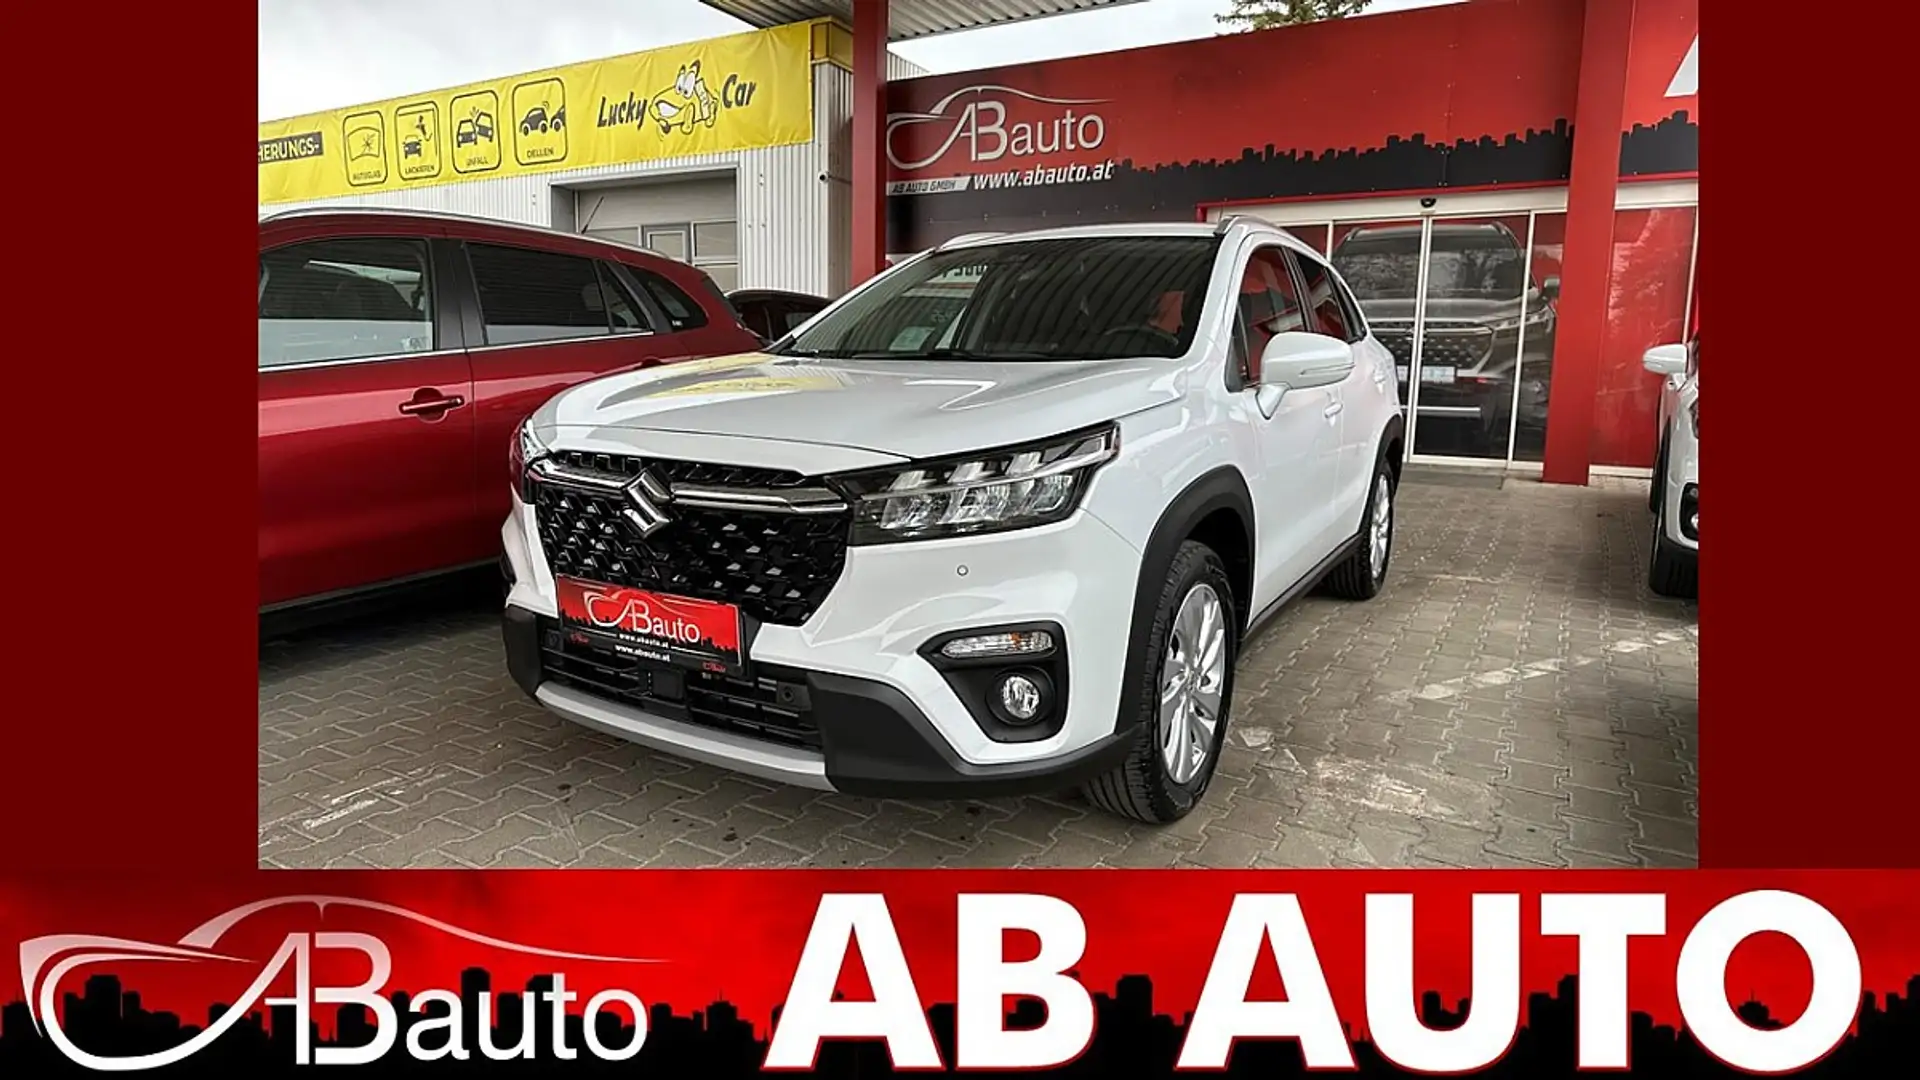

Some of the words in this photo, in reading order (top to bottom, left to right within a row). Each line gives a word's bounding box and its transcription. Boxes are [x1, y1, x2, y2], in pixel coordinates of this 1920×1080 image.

[597, 91, 648, 130] Lucky
[722, 73, 757, 109] Car
[932, 99, 1105, 162] ABauto
[526, 147, 555, 159] DELLEN
[906, 182, 929, 193] AUTO
[973, 159, 1114, 190] www.abauto.at
[615, 598, 701, 643] ABauto
